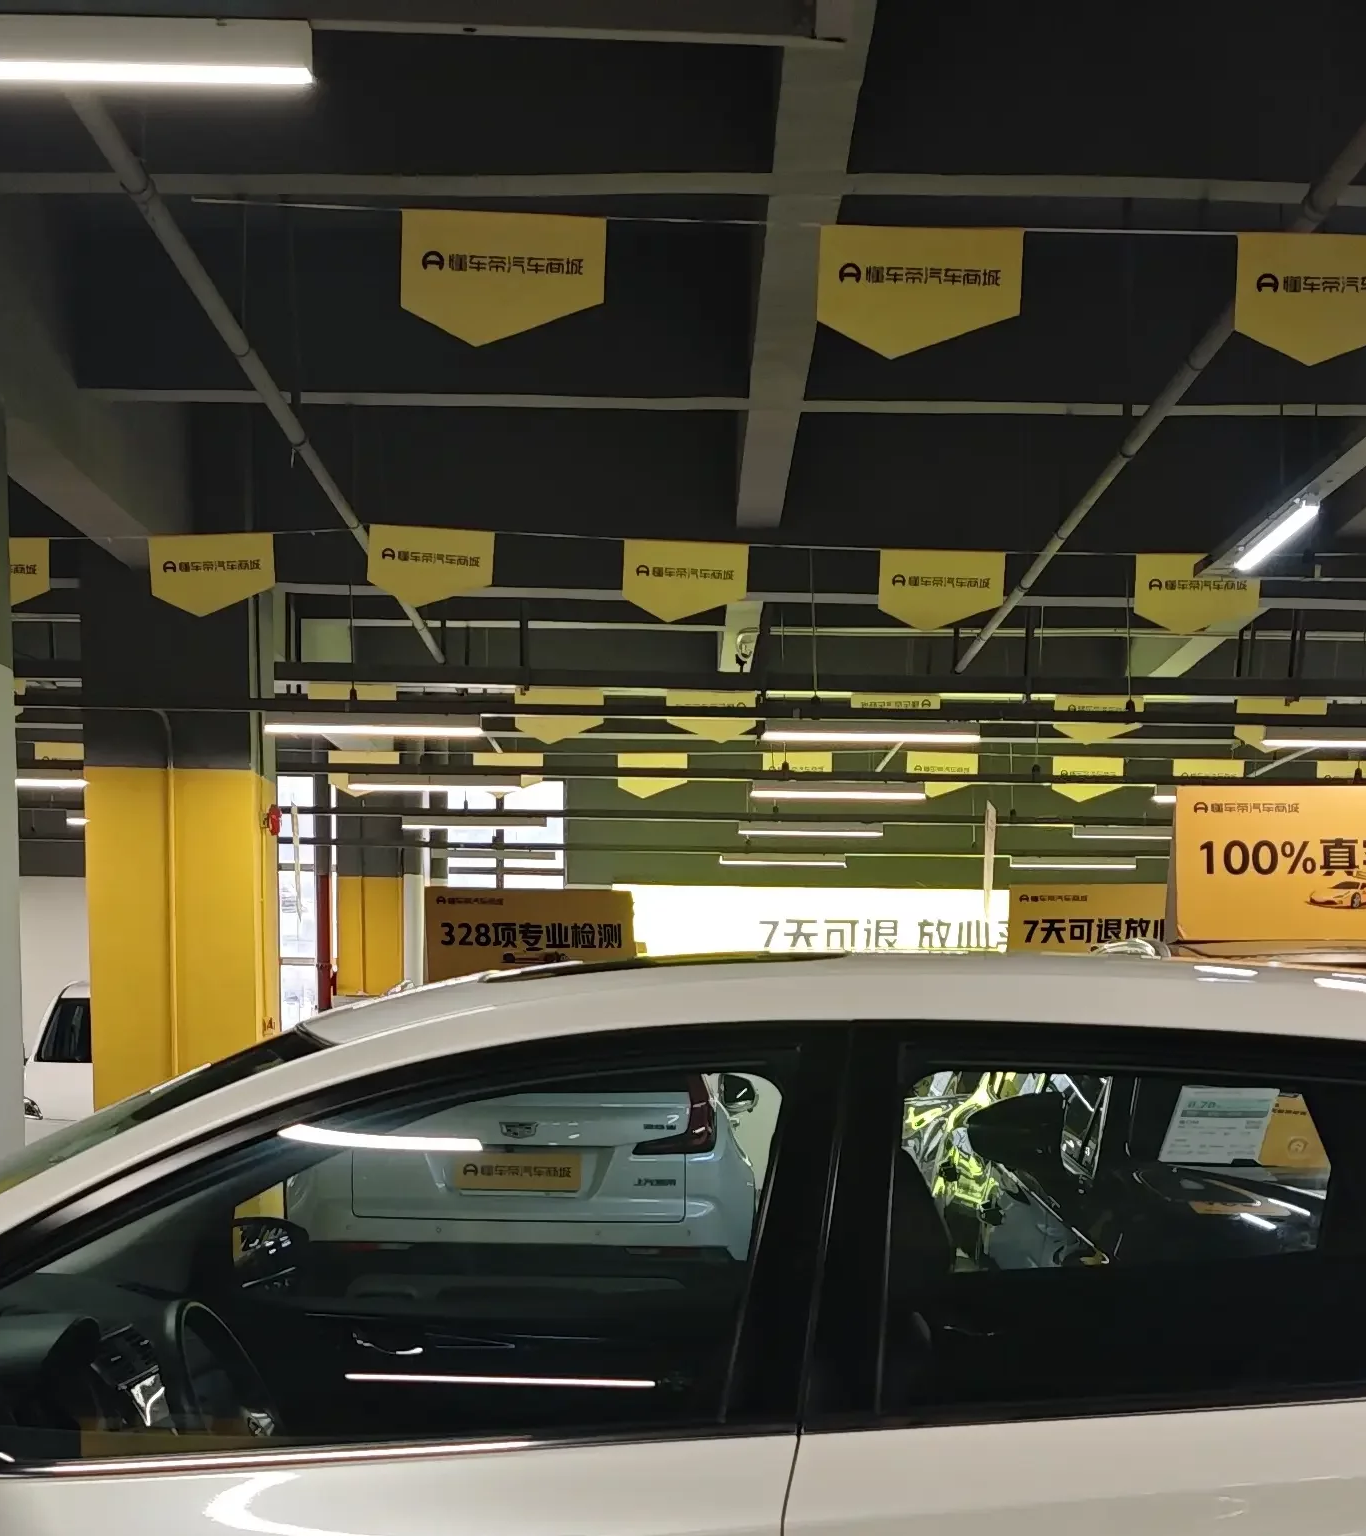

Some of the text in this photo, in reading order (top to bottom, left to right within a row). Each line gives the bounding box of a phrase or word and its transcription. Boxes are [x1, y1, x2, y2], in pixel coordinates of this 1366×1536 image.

[448, 253, 584, 276] 懂车帝汽车商城
[865, 265, 1002, 287] 懂车帝汽车商城
[440, 922, 623, 951] 328项专业检测
